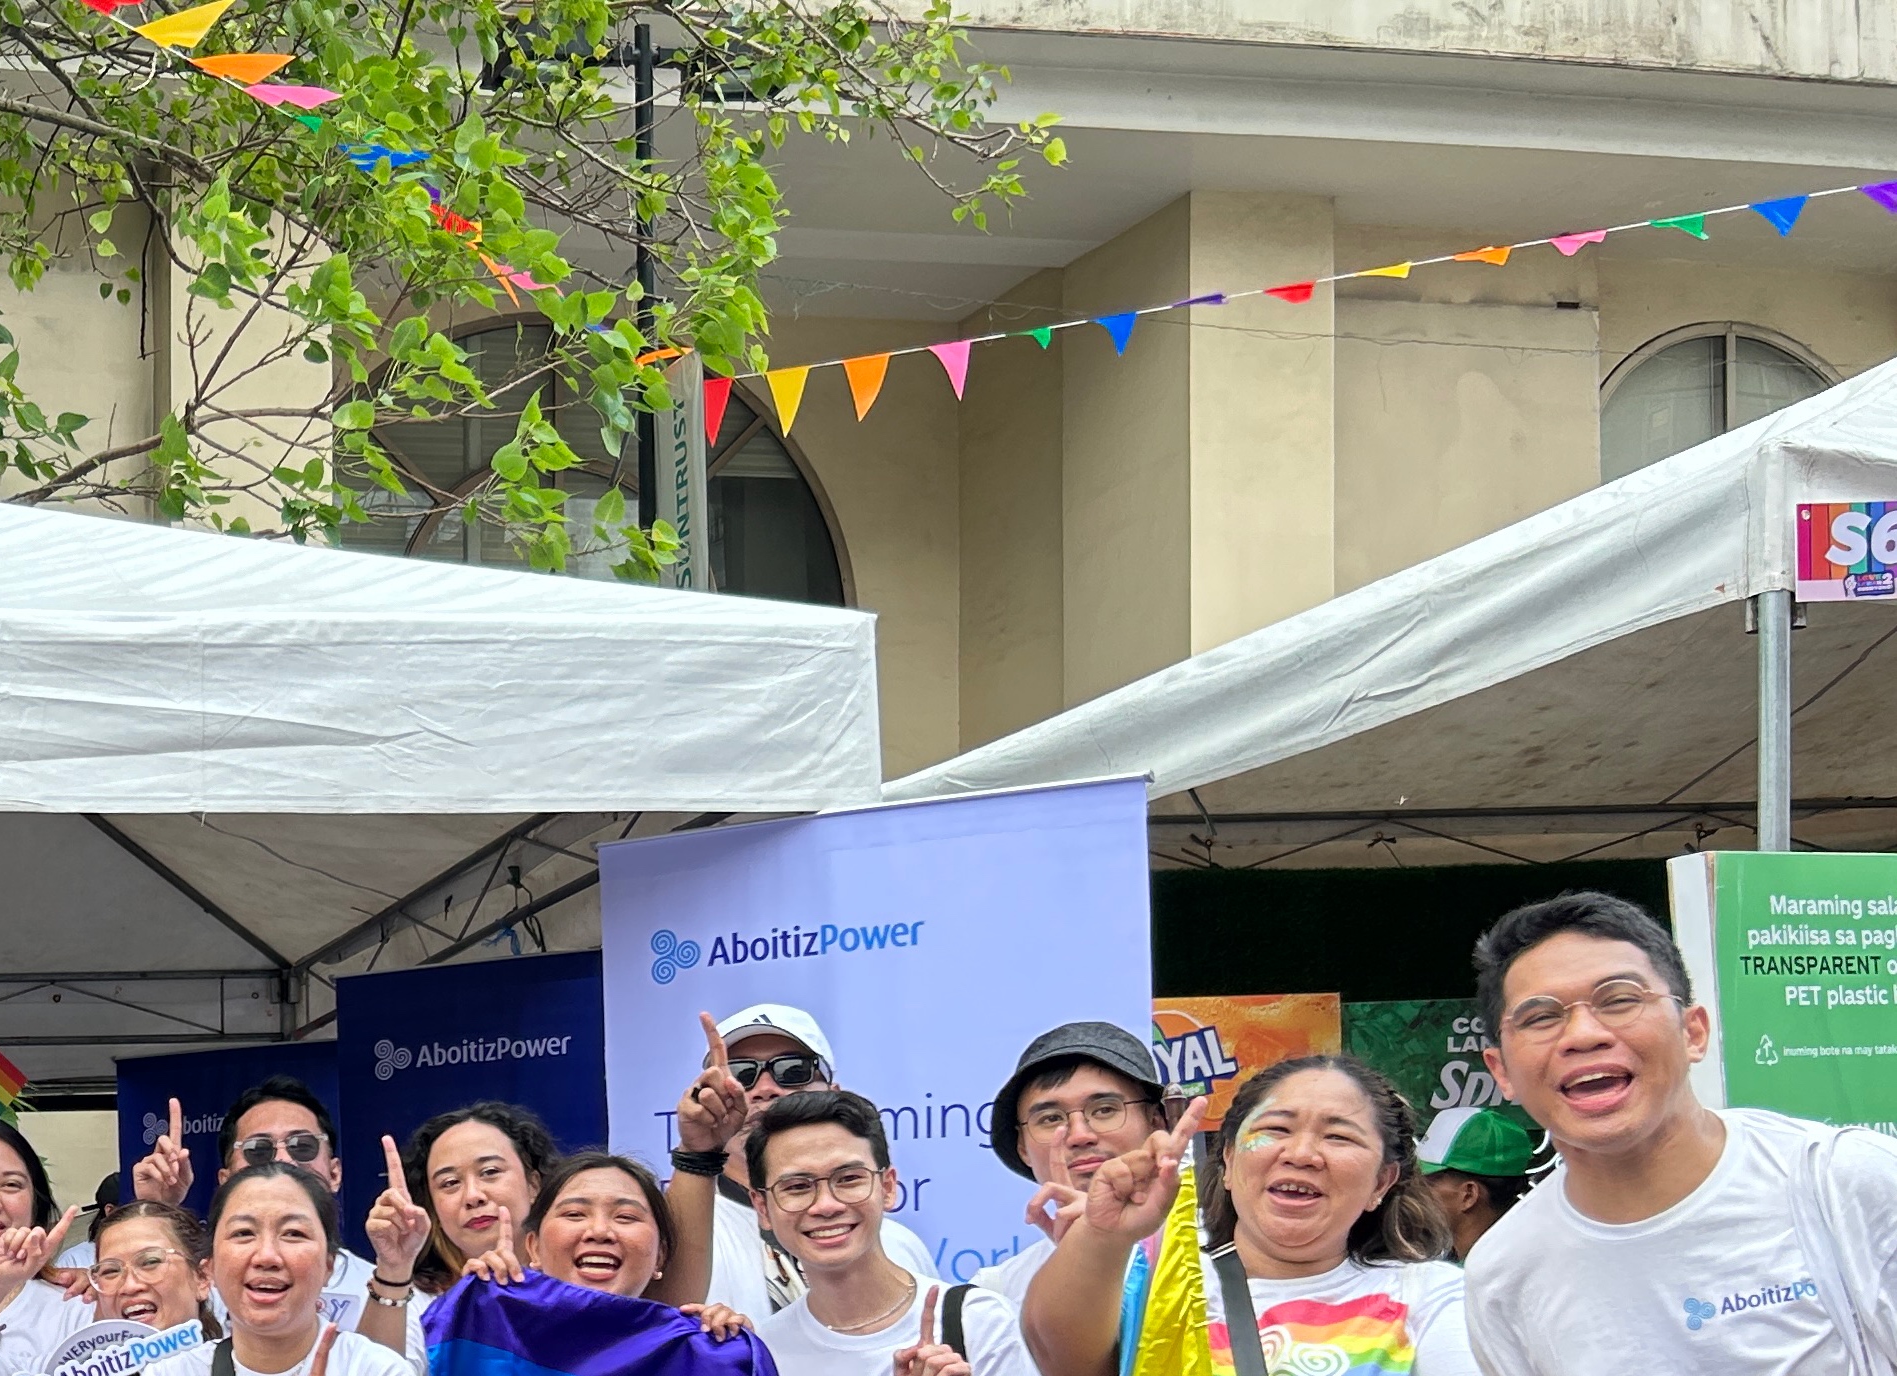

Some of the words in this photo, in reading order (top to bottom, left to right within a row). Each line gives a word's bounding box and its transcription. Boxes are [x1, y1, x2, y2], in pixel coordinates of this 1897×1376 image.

[1769, 894, 1863, 920] Maraming
[707, 920, 926, 968] AboitizPower
[1747, 924, 1831, 950] pakikiisa
[1835, 929, 1857, 946] sa
[1739, 955, 1882, 976] TRANSPARENT
[1784, 985, 1822, 1006] PET
[1826, 984, 1889, 1010] plastic
[415, 1035, 572, 1069] AboitizPower
[1720, 1280, 1818, 1315] AboitizPo
